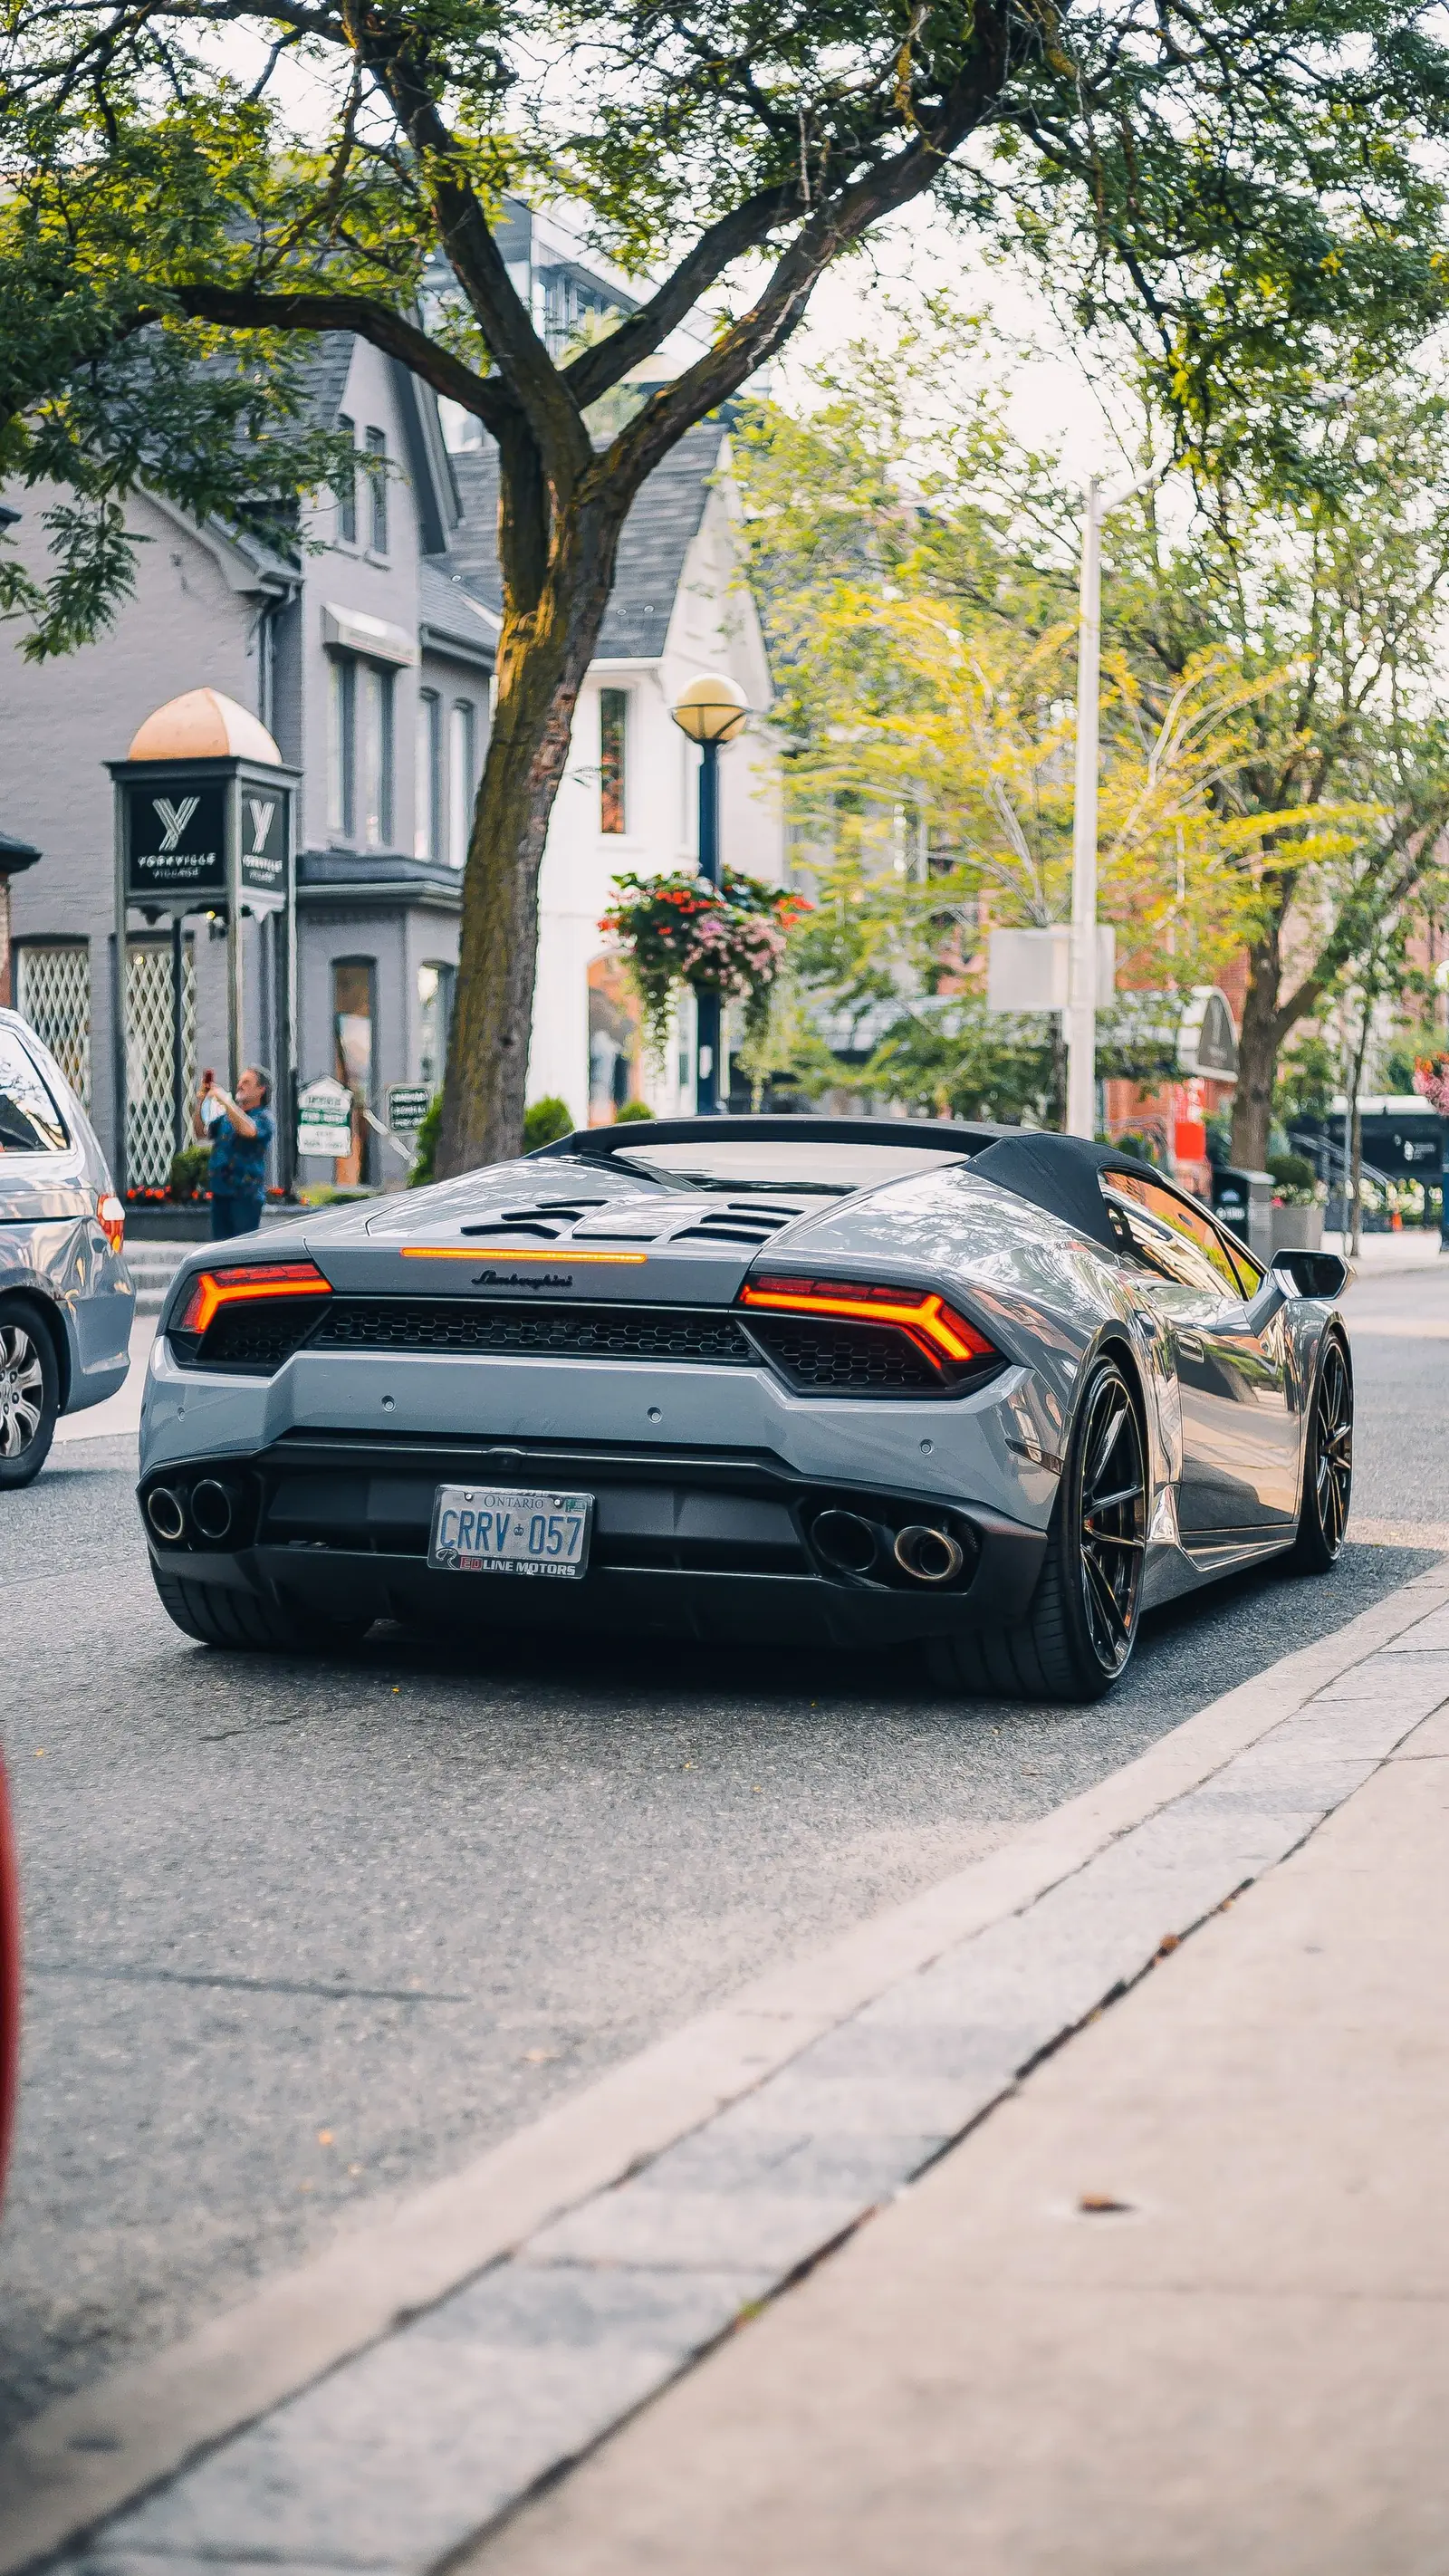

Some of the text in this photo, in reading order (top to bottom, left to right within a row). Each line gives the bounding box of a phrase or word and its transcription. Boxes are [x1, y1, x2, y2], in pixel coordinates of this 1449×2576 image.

[484, 1495, 543, 1510] ONTARIO
[439, 1509, 582, 1556] CRRV 057
[515, 1560, 576, 1576] MOTORS
